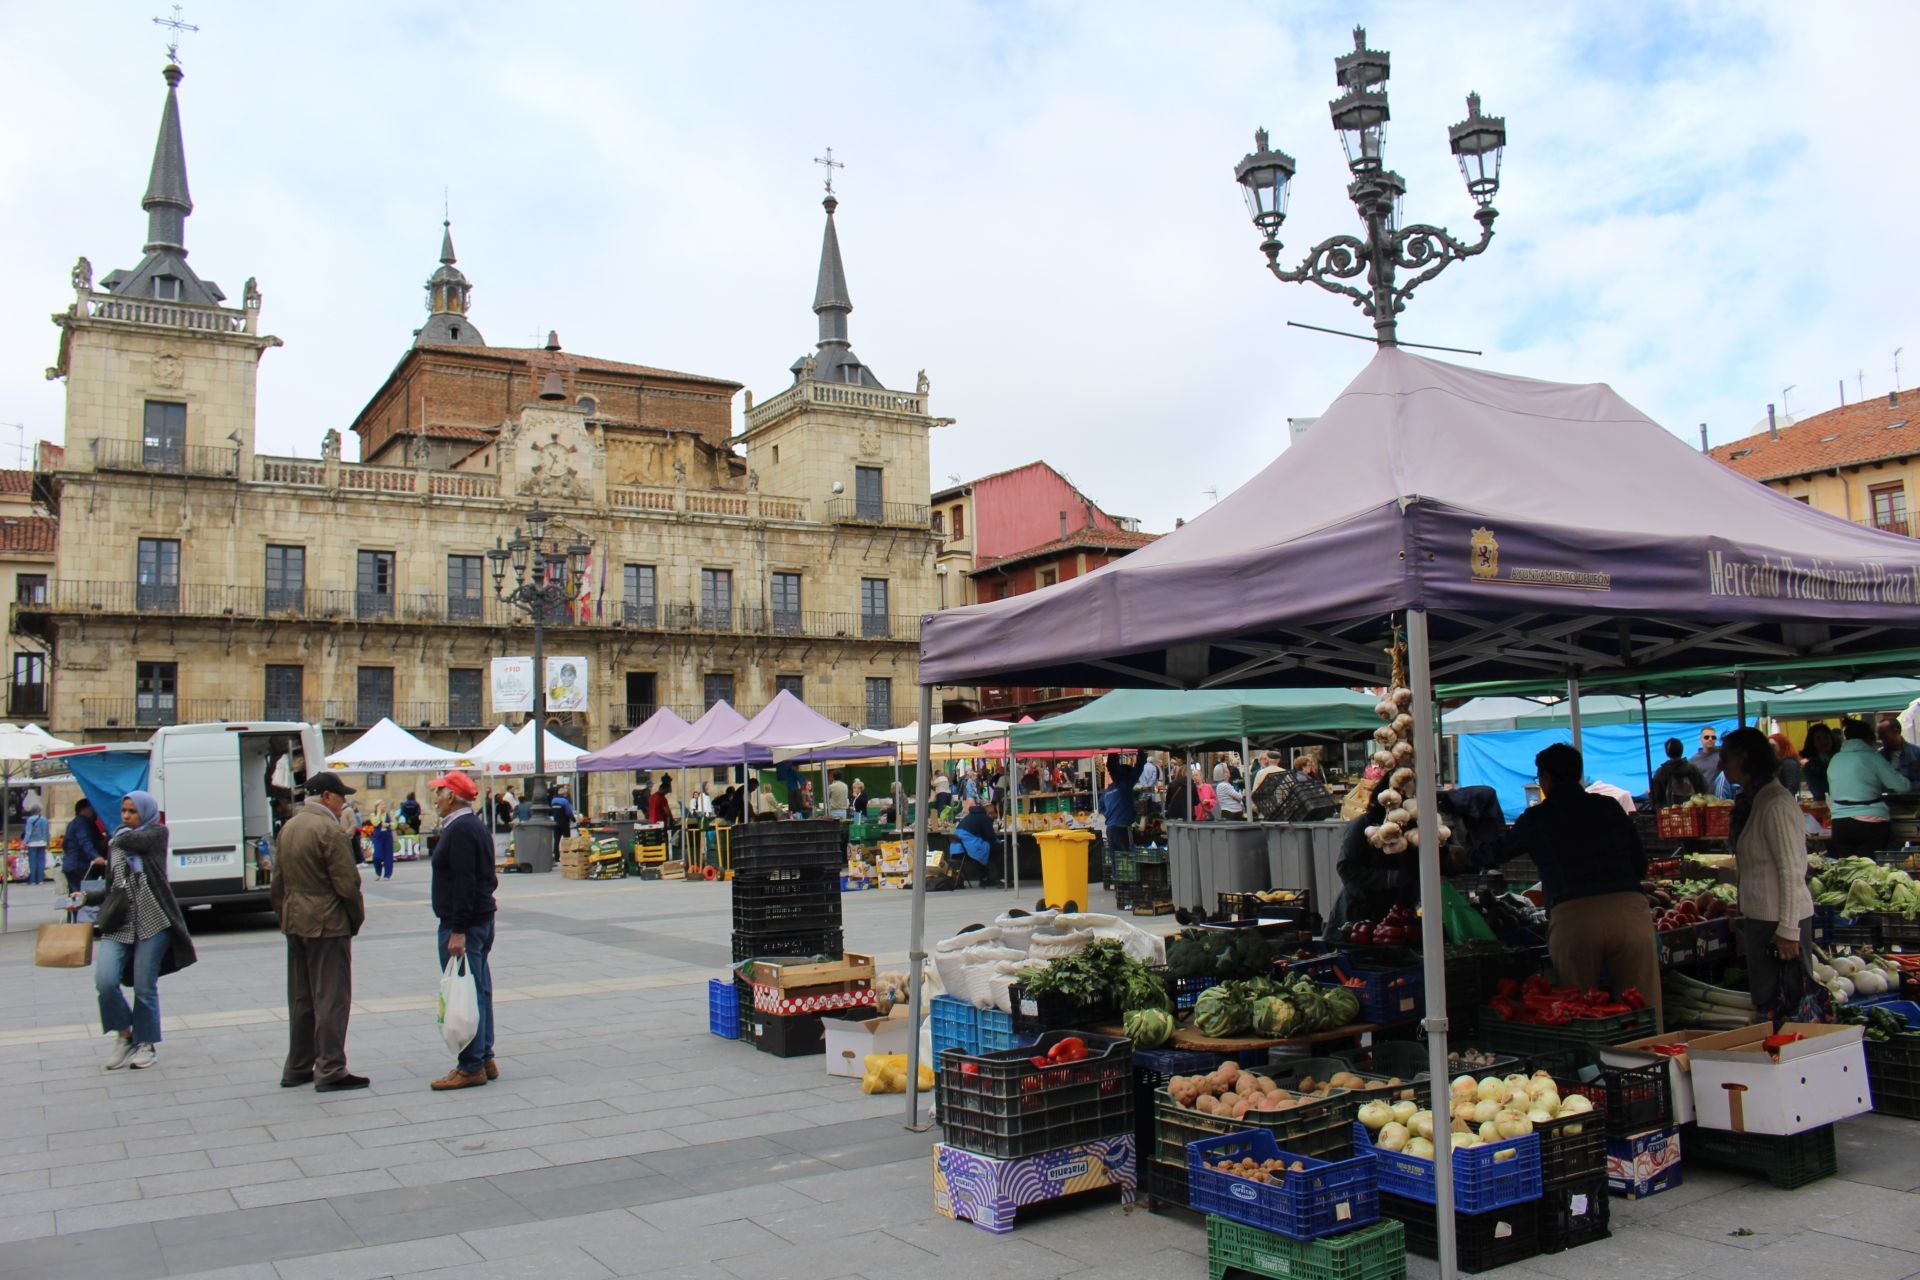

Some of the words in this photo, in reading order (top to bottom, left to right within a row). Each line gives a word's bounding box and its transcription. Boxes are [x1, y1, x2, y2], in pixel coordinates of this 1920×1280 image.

[1510, 567, 1578, 584] AYUNTAMIENTO
[1589, 571, 1611, 586] LEÓN
[1707, 550, 1780, 598] Mercado
[1781, 556, 1870, 601] Tradicional
[1871, 562, 1910, 604] Plaza
[1050, 1163, 1086, 1178] Platania
